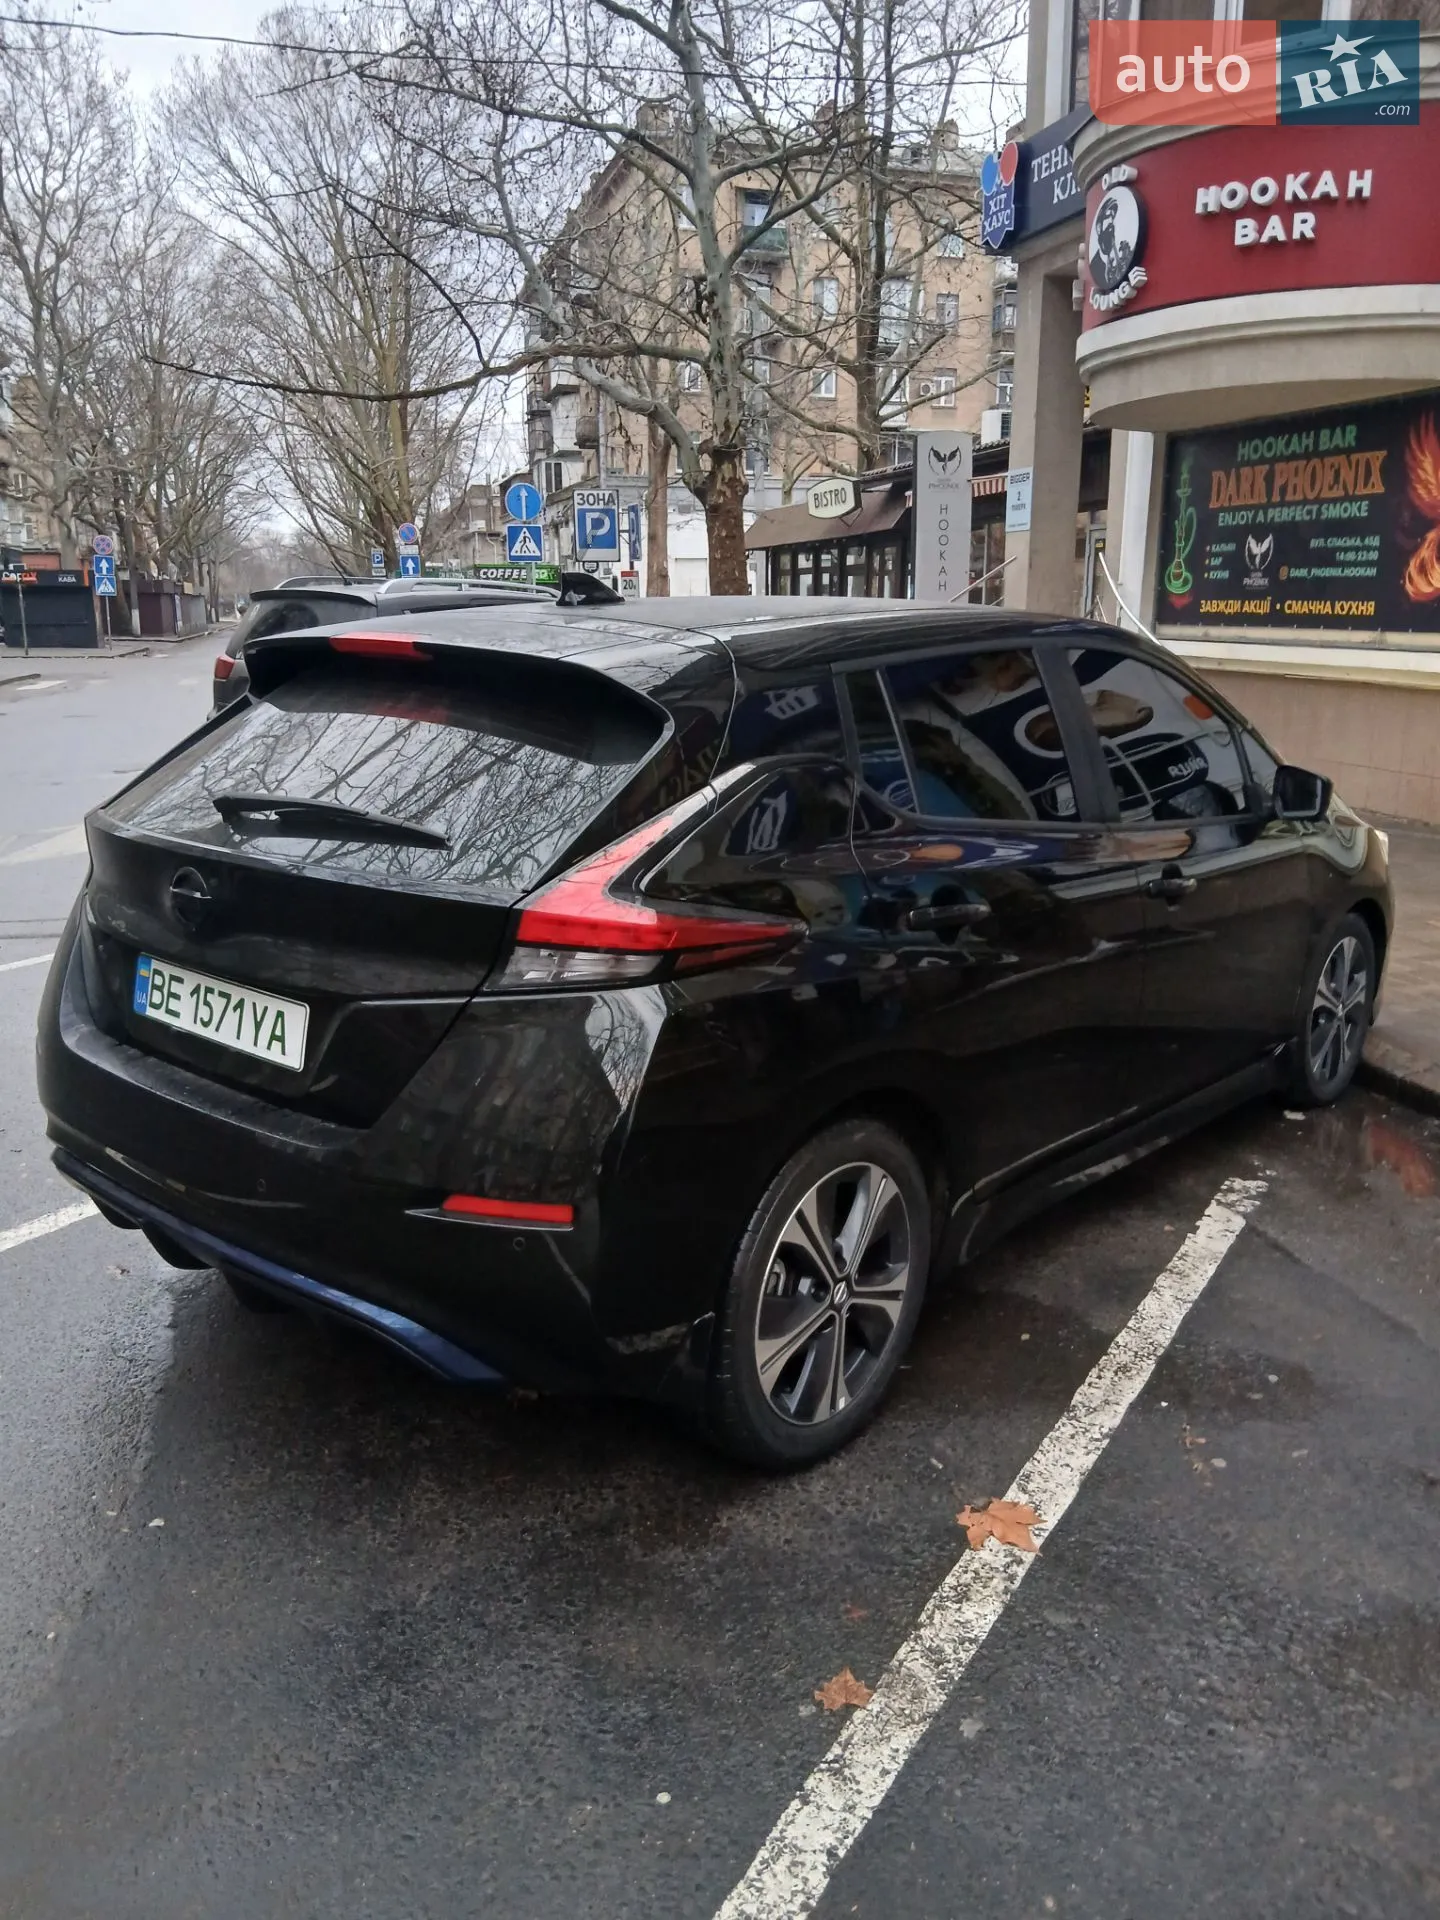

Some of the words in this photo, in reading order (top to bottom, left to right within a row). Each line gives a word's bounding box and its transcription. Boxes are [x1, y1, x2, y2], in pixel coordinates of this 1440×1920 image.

[1031, 144, 1074, 183] ТЕНІ
[1102, 164, 1135, 190] OLD
[1053, 171, 1081, 204] КЛ
[1195, 169, 1373, 216] HOOKAH
[984, 209, 1011, 235] ХАУС
[1234, 212, 1316, 247] BAR
[1089, 266, 1148, 310] LOUNGE
[1237, 430, 1315, 462] HOOKAH
[1318, 424, 1358, 451] BAR
[1209, 464, 1269, 509] DARK
[1271, 450, 1387, 503] PHOENIX
[576, 492, 616, 506] ЗОНА
[812, 487, 847, 509] BISTRO
[1218, 509, 1254, 527] ENJOY
[1256, 509, 1264, 524] A
[1267, 504, 1321, 523] PERFECT
[1320, 501, 1369, 520] SMOKE
[585, 511, 611, 545] P
[937, 503, 949, 592] HOOKAH
[479, 568, 527, 579] COFFEE
[1199, 599, 1241, 615] ЗАВЖДИ
[1242, 596, 1272, 615] АКЦІЇ
[1284, 600, 1332, 615] СМАЧНА
[1334, 600, 1376, 616] КУХНЯ
[136, 993, 147, 1005] UA
[148, 968, 185, 1019] BE
[189, 983, 246, 1041] 1571
[252, 1001, 287, 1057] YA
